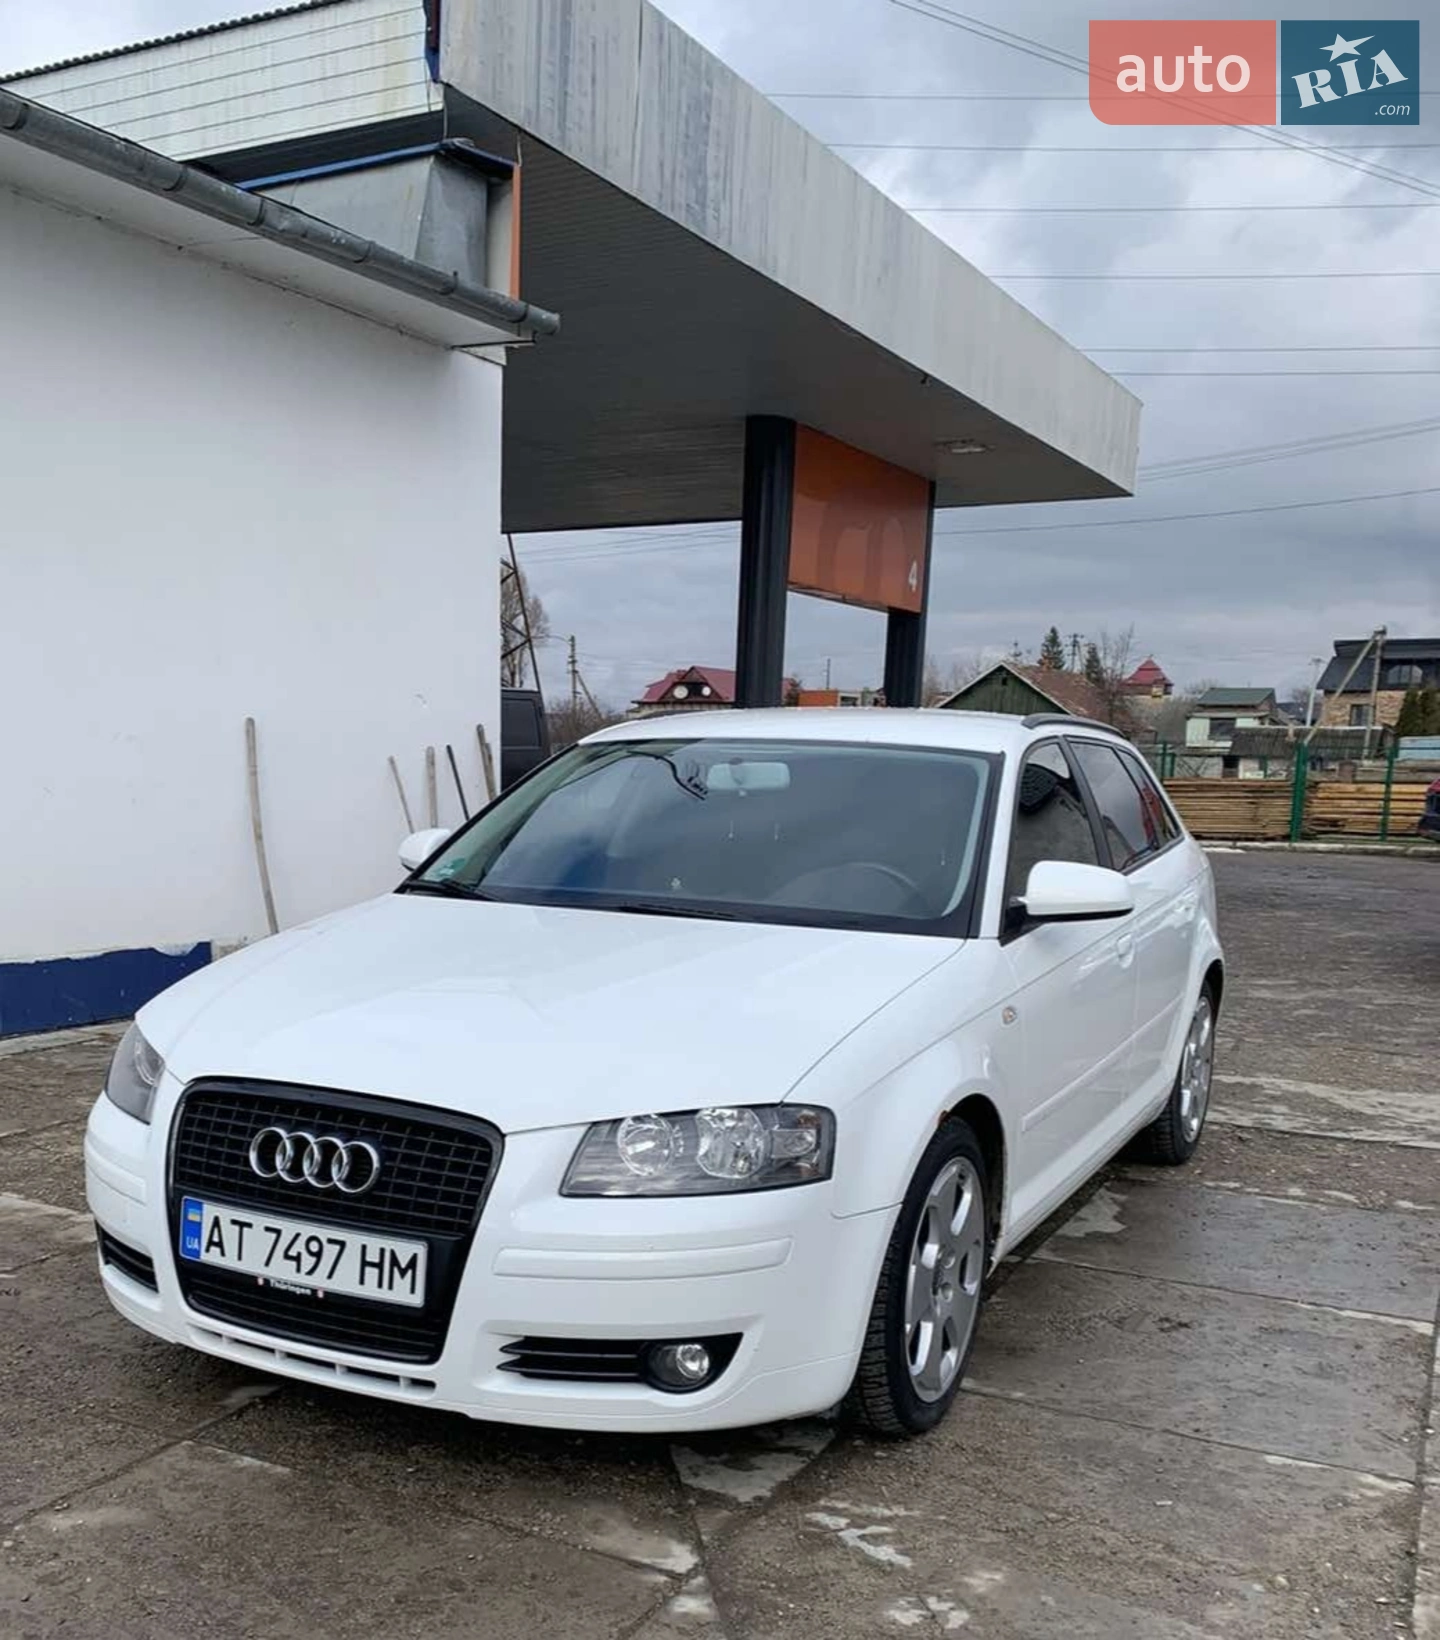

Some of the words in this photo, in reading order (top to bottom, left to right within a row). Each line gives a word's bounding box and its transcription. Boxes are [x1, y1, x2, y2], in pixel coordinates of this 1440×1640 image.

[907, 560, 919, 593] 4
[186, 1236, 200, 1251] UA
[205, 1214, 254, 1262] AT
[263, 1225, 347, 1280] 7497
[358, 1243, 419, 1295] HM
